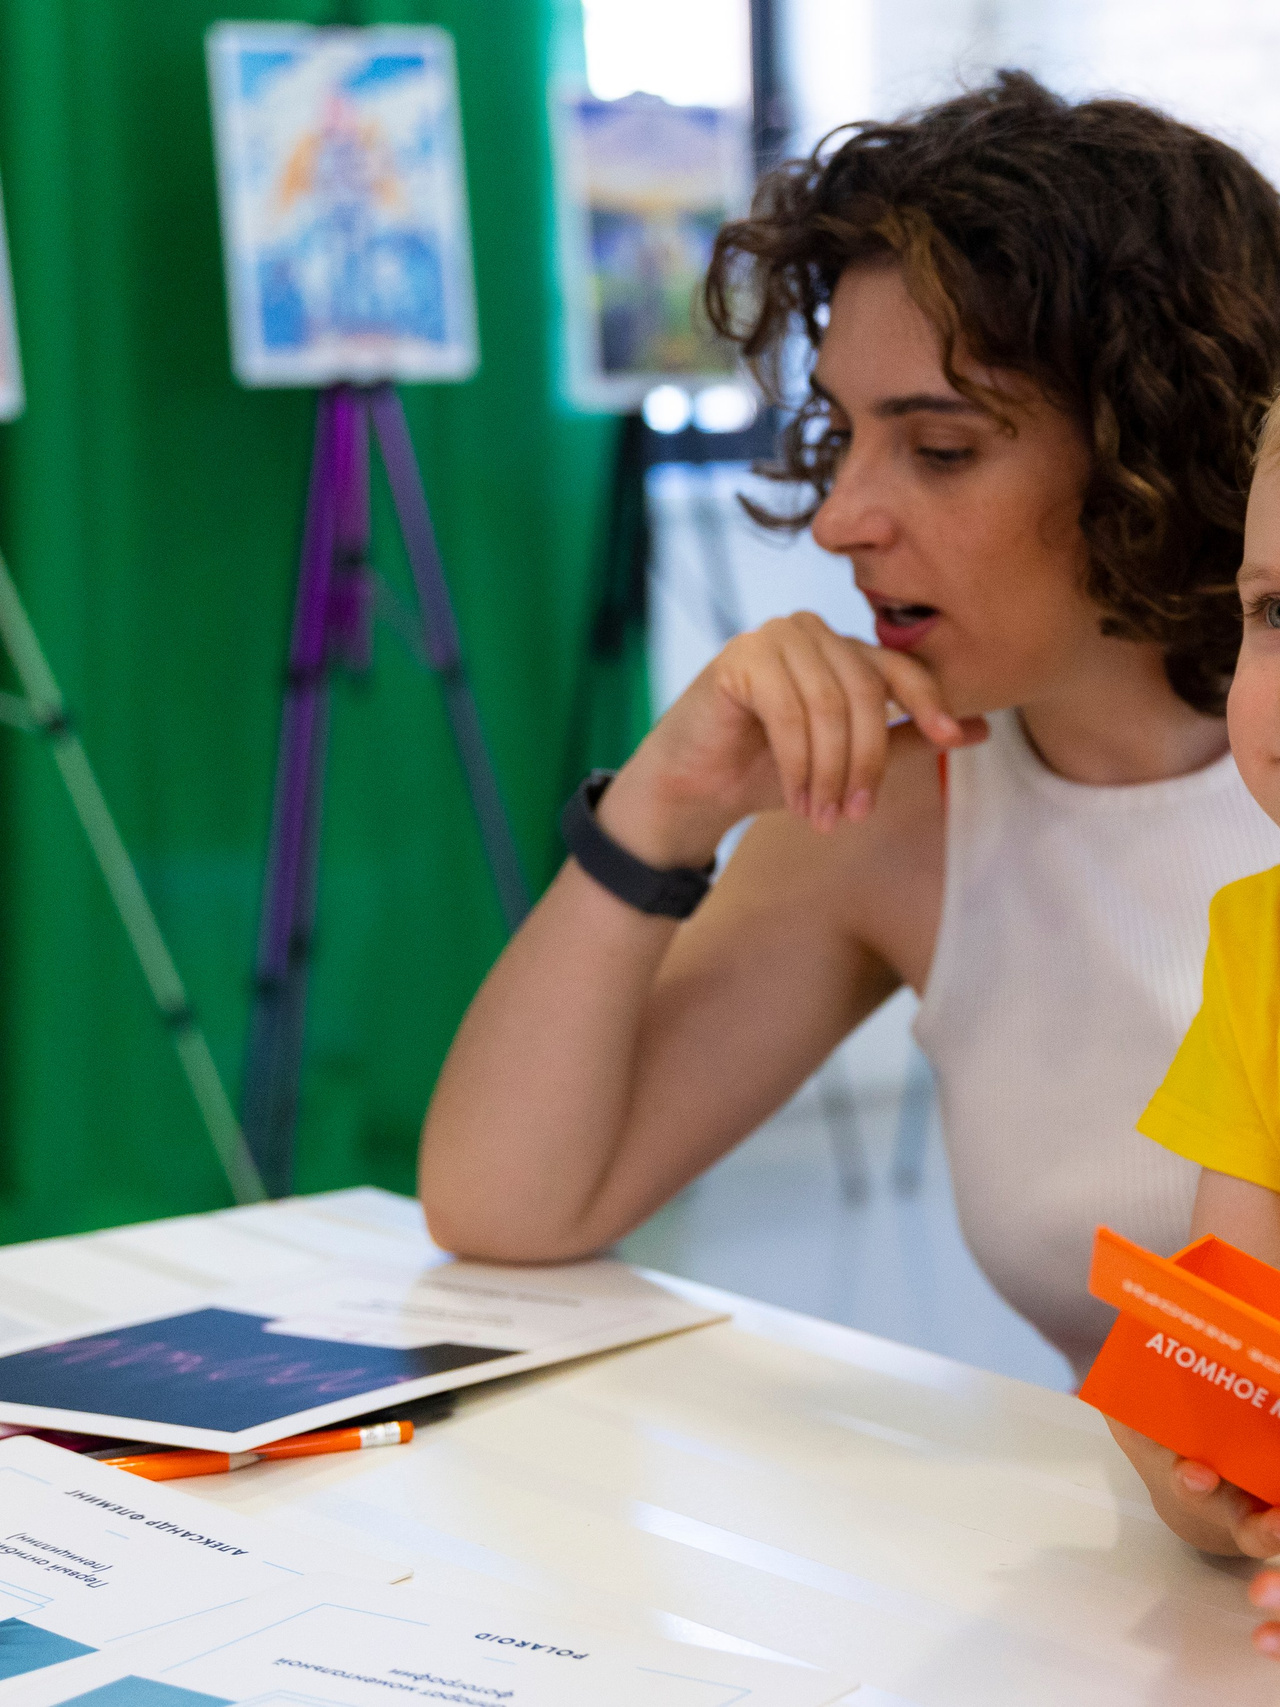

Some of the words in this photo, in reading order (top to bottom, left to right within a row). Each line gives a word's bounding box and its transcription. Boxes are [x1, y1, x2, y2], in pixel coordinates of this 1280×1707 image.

[1145, 1332, 1270, 1408] АТОМНОЕ
[64, 1489, 145, 1521] ФЛЕМИНГ
[5, 1532, 113, 1573] (пенициллин)
[145, 1519, 249, 1557] АЛЕКСАНДР
[43, 1563, 109, 1588] Первый
[474, 1632, 590, 1660] POLAROID
